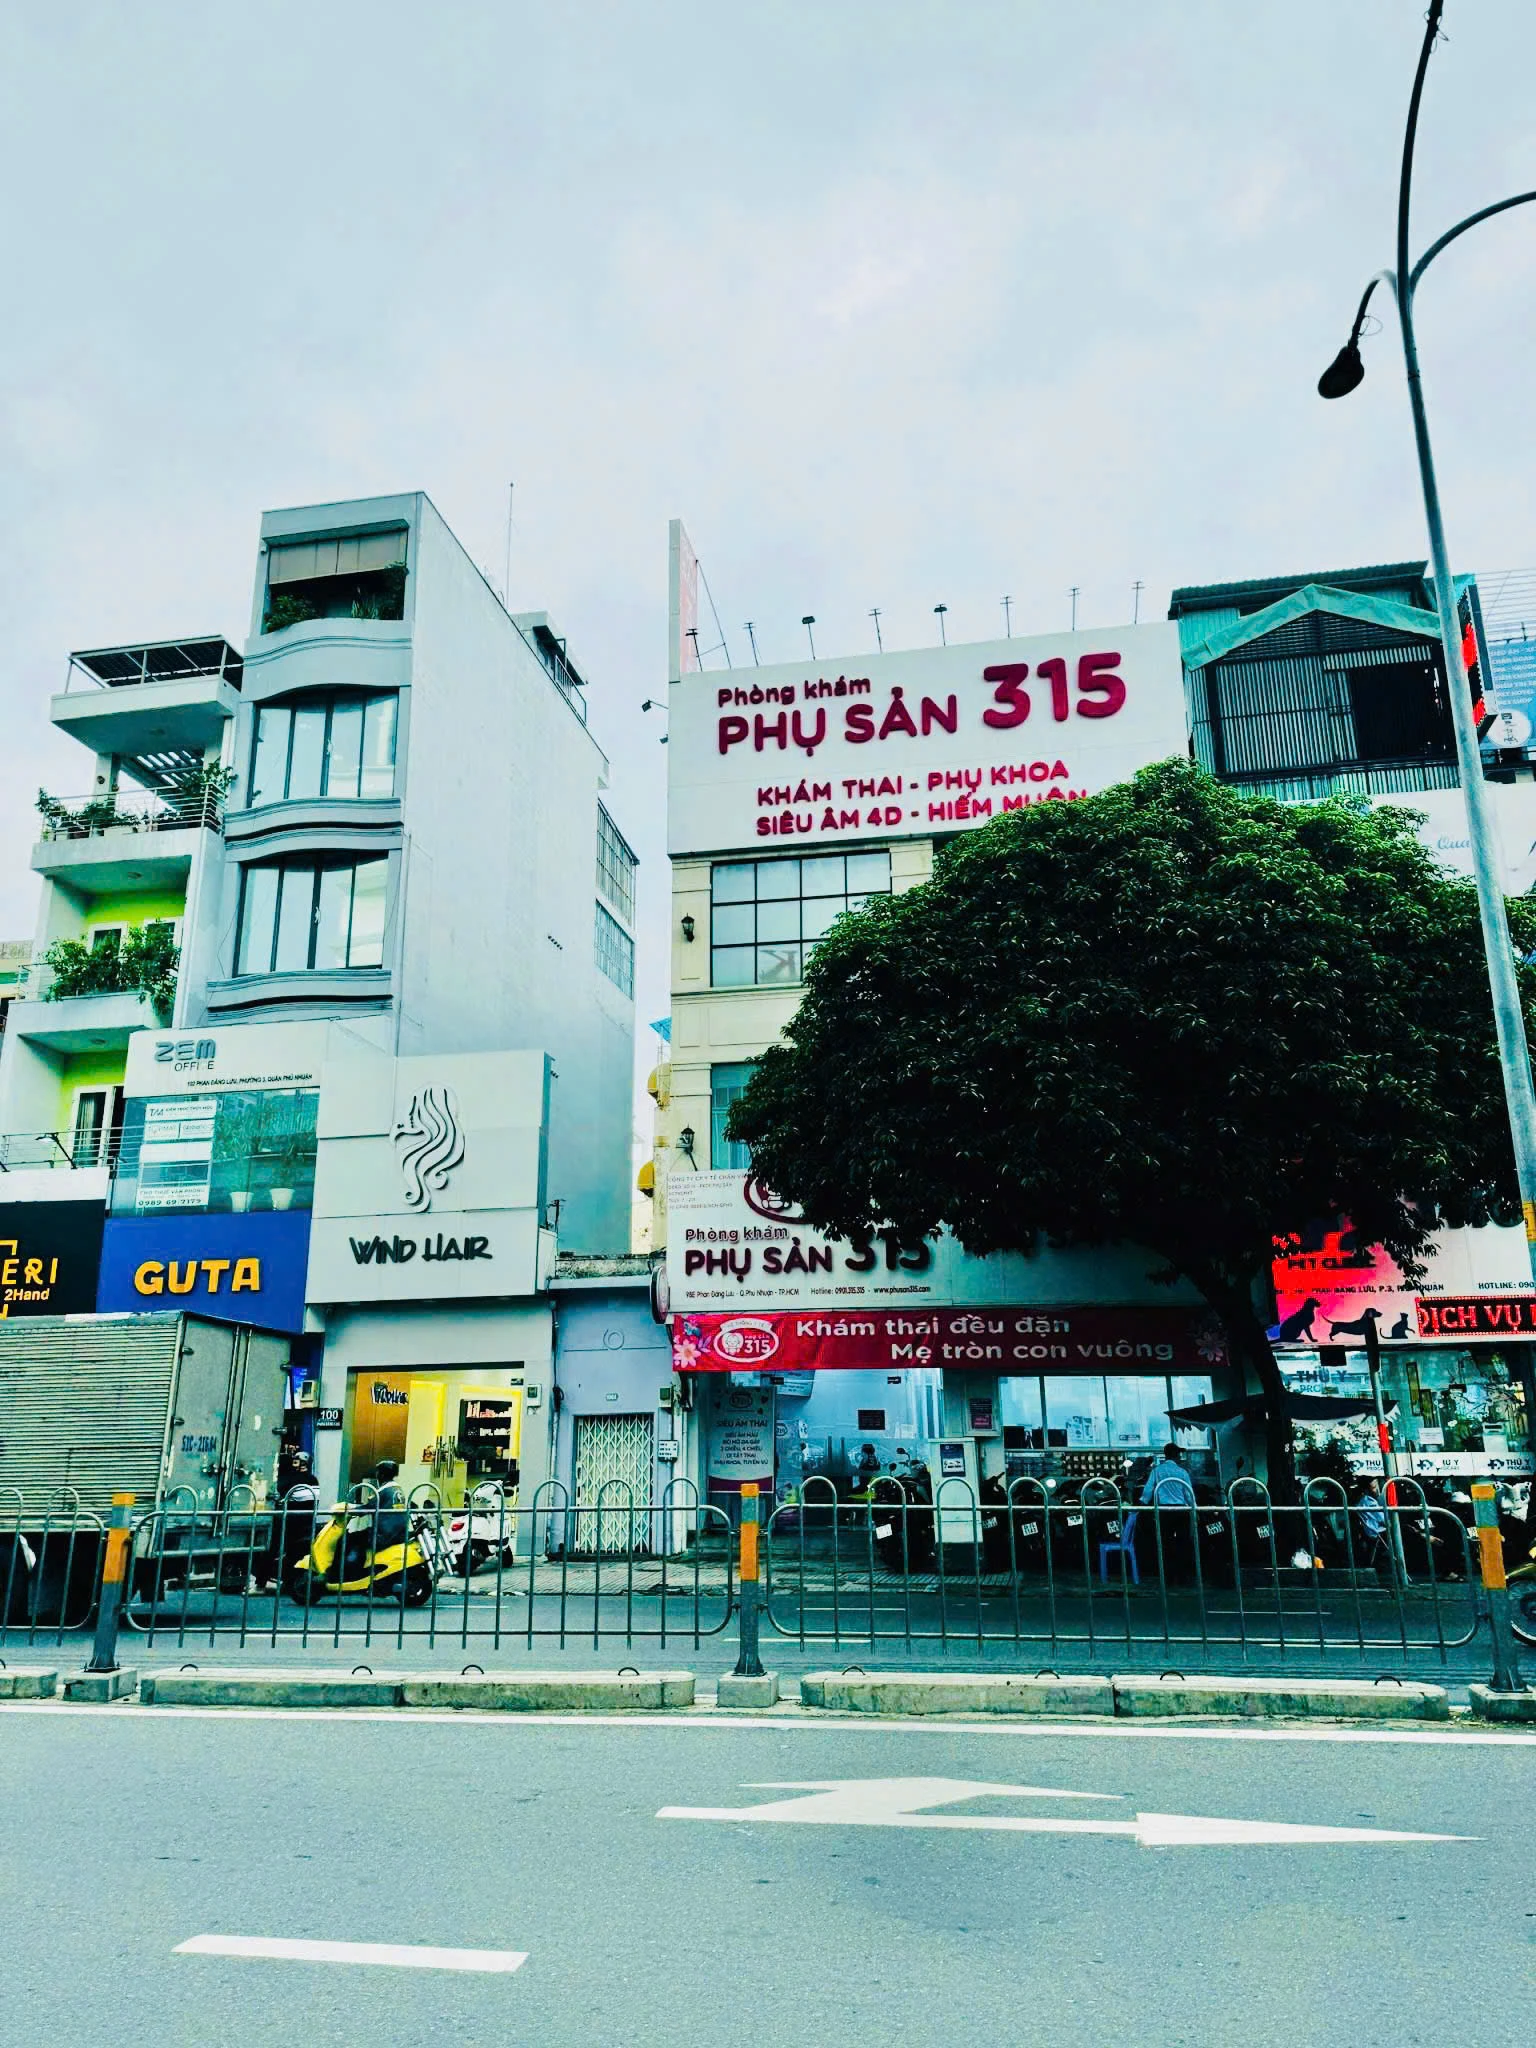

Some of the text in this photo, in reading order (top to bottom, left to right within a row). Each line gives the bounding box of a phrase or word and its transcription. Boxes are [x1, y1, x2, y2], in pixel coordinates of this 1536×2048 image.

[718, 675, 871, 708] Phòng khám
[718, 651, 1127, 757] PHỤ SẢN 315
[757, 778, 831, 806] KHÁM
[842, 775, 902, 799] THAI
[928, 767, 982, 792] PHỤ
[990, 760, 1069, 786] KHOA
[756, 810, 813, 836] SIÊU
[820, 806, 860, 832] ÂM
[866, 806, 902, 826] 4D
[928, 791, 992, 822] HIẾM
[154, 1038, 216, 1062] ZEM
[685, 1226, 789, 1244] Phòng khám
[348, 1232, 493, 1264] WIND HAIR
[684, 1248, 752, 1283] PHỤ
[762, 1236, 833, 1275] SẢN
[134, 1257, 260, 1296] GUTA
[1478, 1282, 1516, 1290] HOTLINE:
[4, 1288, 50, 1302] 2Hand
[810, 1287, 834, 1296] Hotline:
[874, 1285, 932, 1296] www.phusan315.com
[1378, 1284, 1394, 1294] P.3,
[796, 1314, 1070, 1338] Khám thai đều đặn
[1483, 1304, 1522, 1332] VỤ
[744, 1340, 770, 1354] 315
[891, 1339, 1173, 1364] Mẹ tròn con vuông
[320, 1410, 338, 1420] 100
[750, 1420, 768, 1428] THAI
